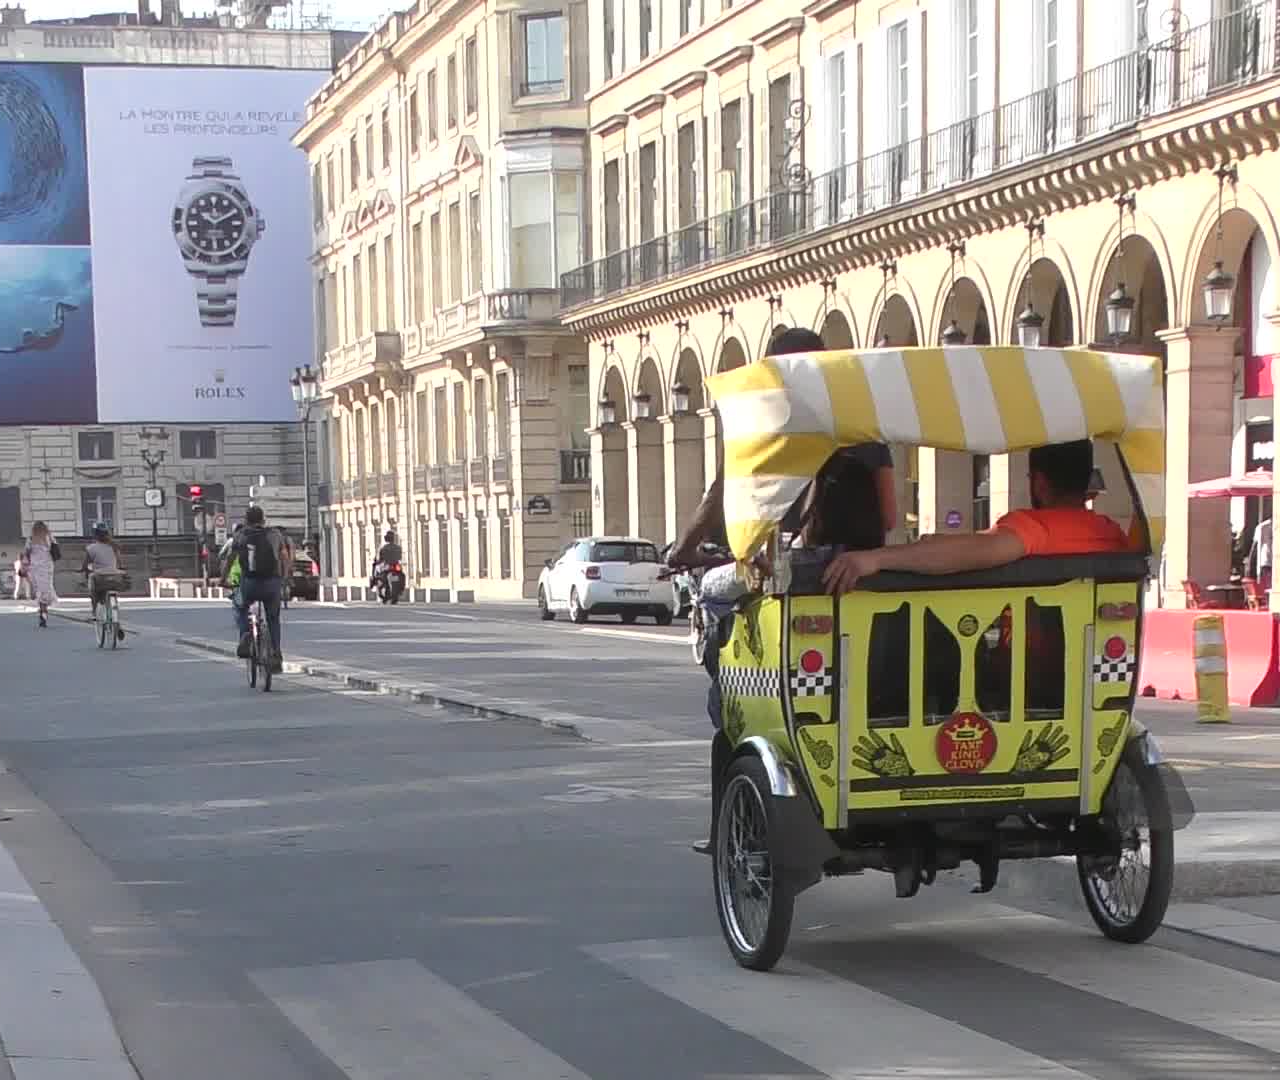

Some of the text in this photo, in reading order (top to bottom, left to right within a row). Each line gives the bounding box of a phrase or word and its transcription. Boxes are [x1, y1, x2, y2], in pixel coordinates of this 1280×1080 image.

[119, 110, 137, 121] LA
[141, 108, 200, 122] MONTRE
[144, 123, 277, 136] LES PROFONDEURS
[195, 387, 246, 399] ROLEX
